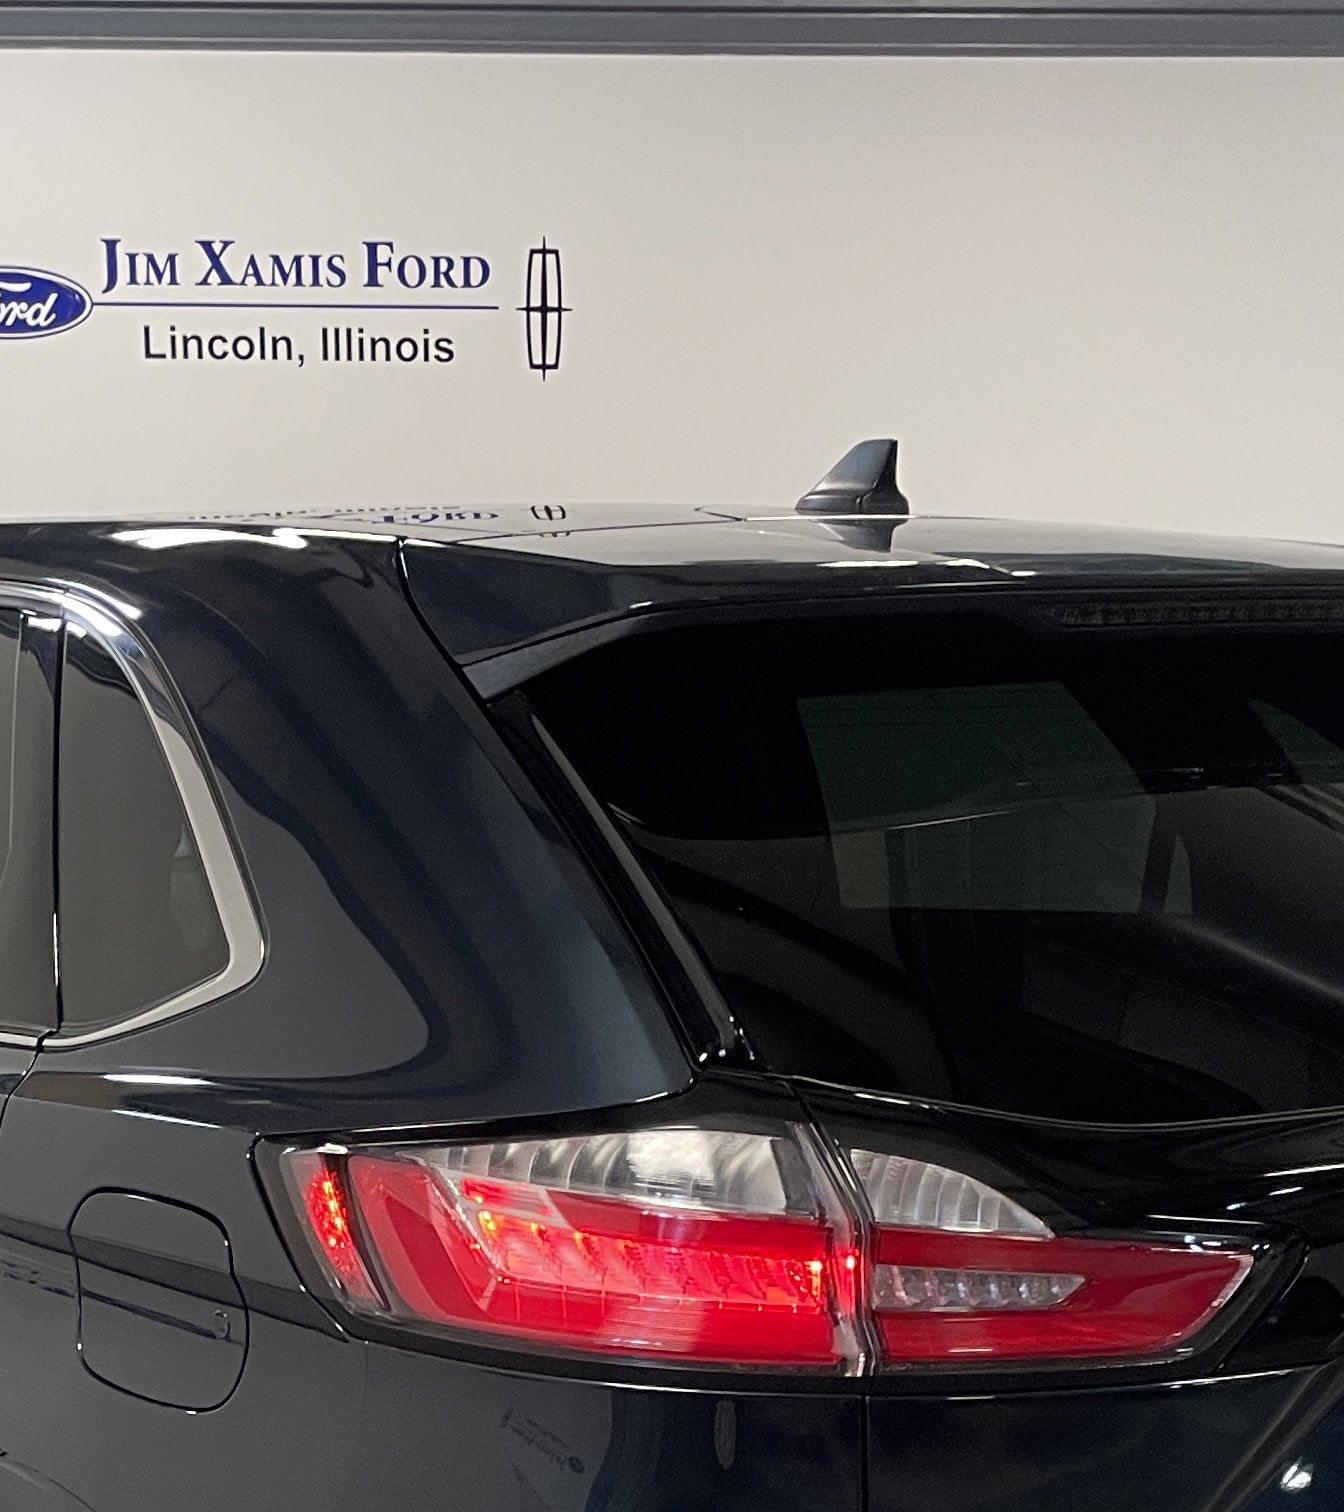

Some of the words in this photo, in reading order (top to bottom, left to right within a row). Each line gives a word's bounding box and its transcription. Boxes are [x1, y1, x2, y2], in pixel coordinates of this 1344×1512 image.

[100, 238, 181, 294] JIM
[194, 239, 347, 289] XAMIS
[361, 241, 490, 289] FORD
[143, 325, 305, 368] Lincoln,
[321, 327, 455, 363] Illinois
